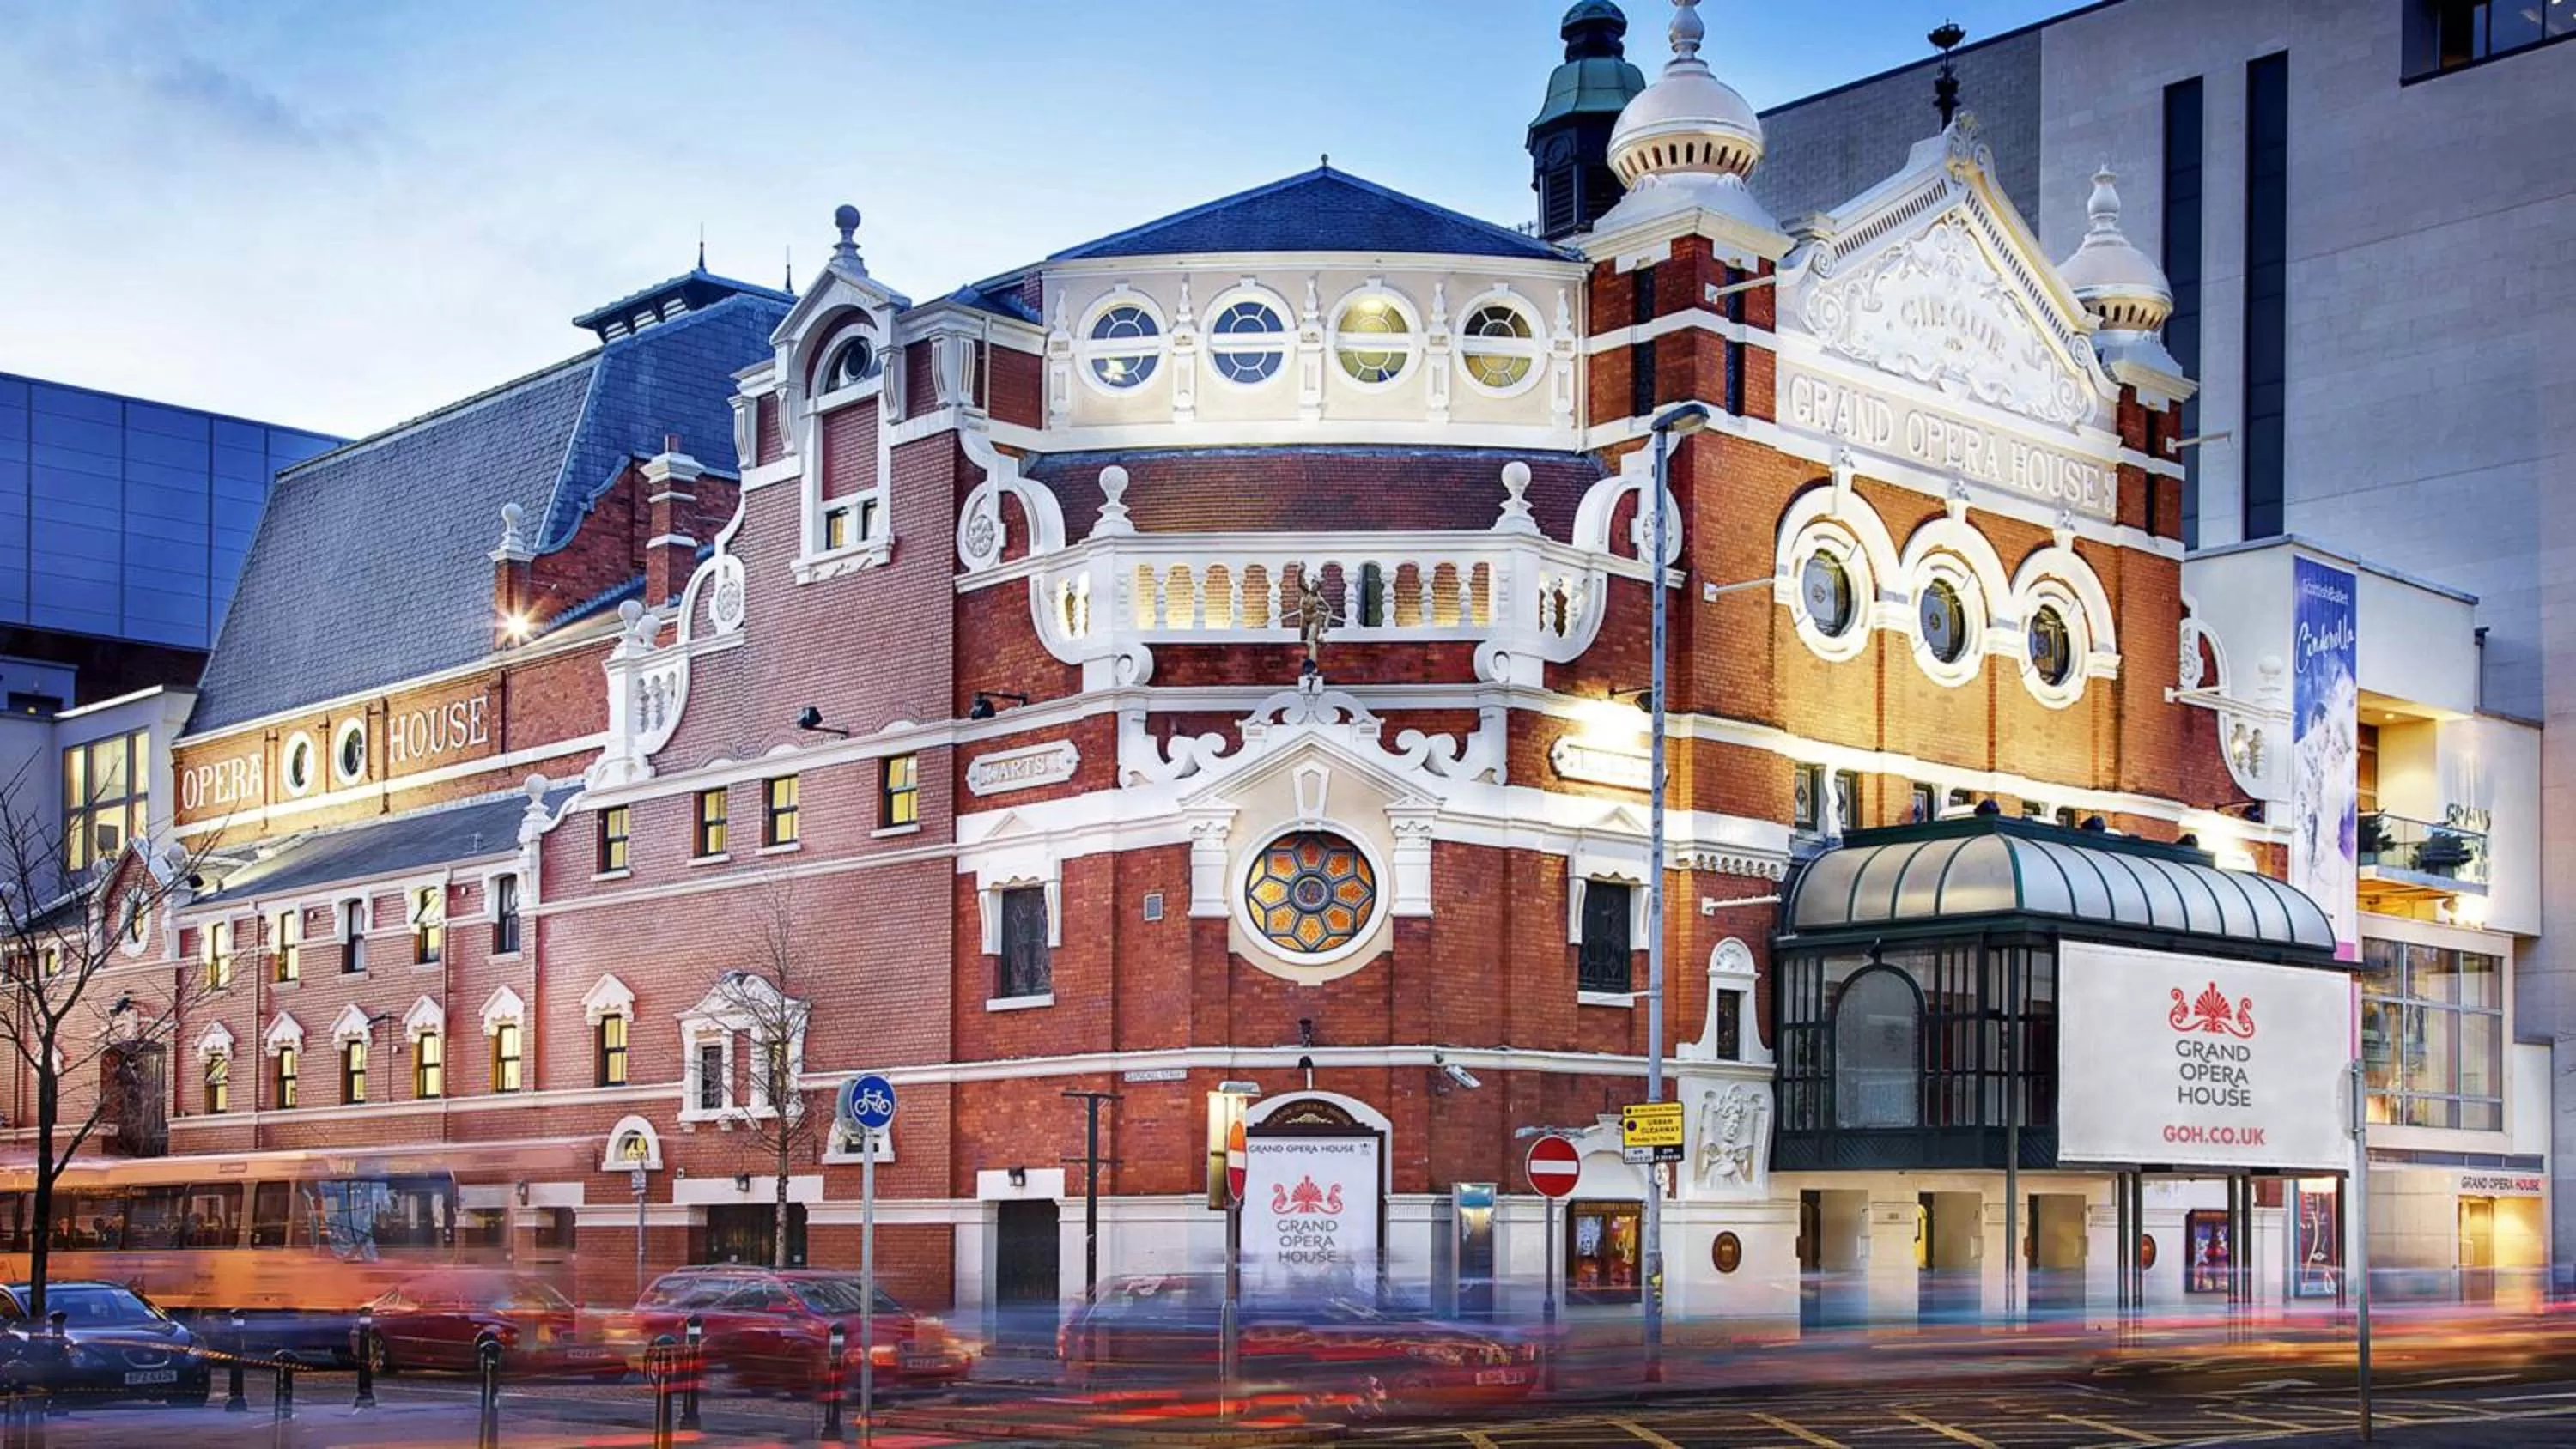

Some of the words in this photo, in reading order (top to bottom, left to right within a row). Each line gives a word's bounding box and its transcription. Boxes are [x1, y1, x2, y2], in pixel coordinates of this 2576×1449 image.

[1789, 373, 1894, 446] GRAND
[1906, 408, 2002, 482] OPERA
[2010, 439, 2099, 509] HOUSE
[181, 752, 263, 810] OPERA
[388, 695, 489, 763] HOUSE
[2175, 1039, 2251, 1064] GRAND
[2179, 1062, 2249, 1088] OPERA
[2178, 1085, 2251, 1106] HOUSE
[2163, 1124, 2265, 1146] GOH.CO.UK
[1248, 1143, 1284, 1155] GRAND
[1286, 1143, 1318, 1155] OPERA
[1321, 1143, 1354, 1153] HOUSE
[1277, 1219, 1339, 1235] GRAND
[1279, 1234, 1335, 1251] OPERA
[1278, 1250, 1337, 1264] HOUSE
